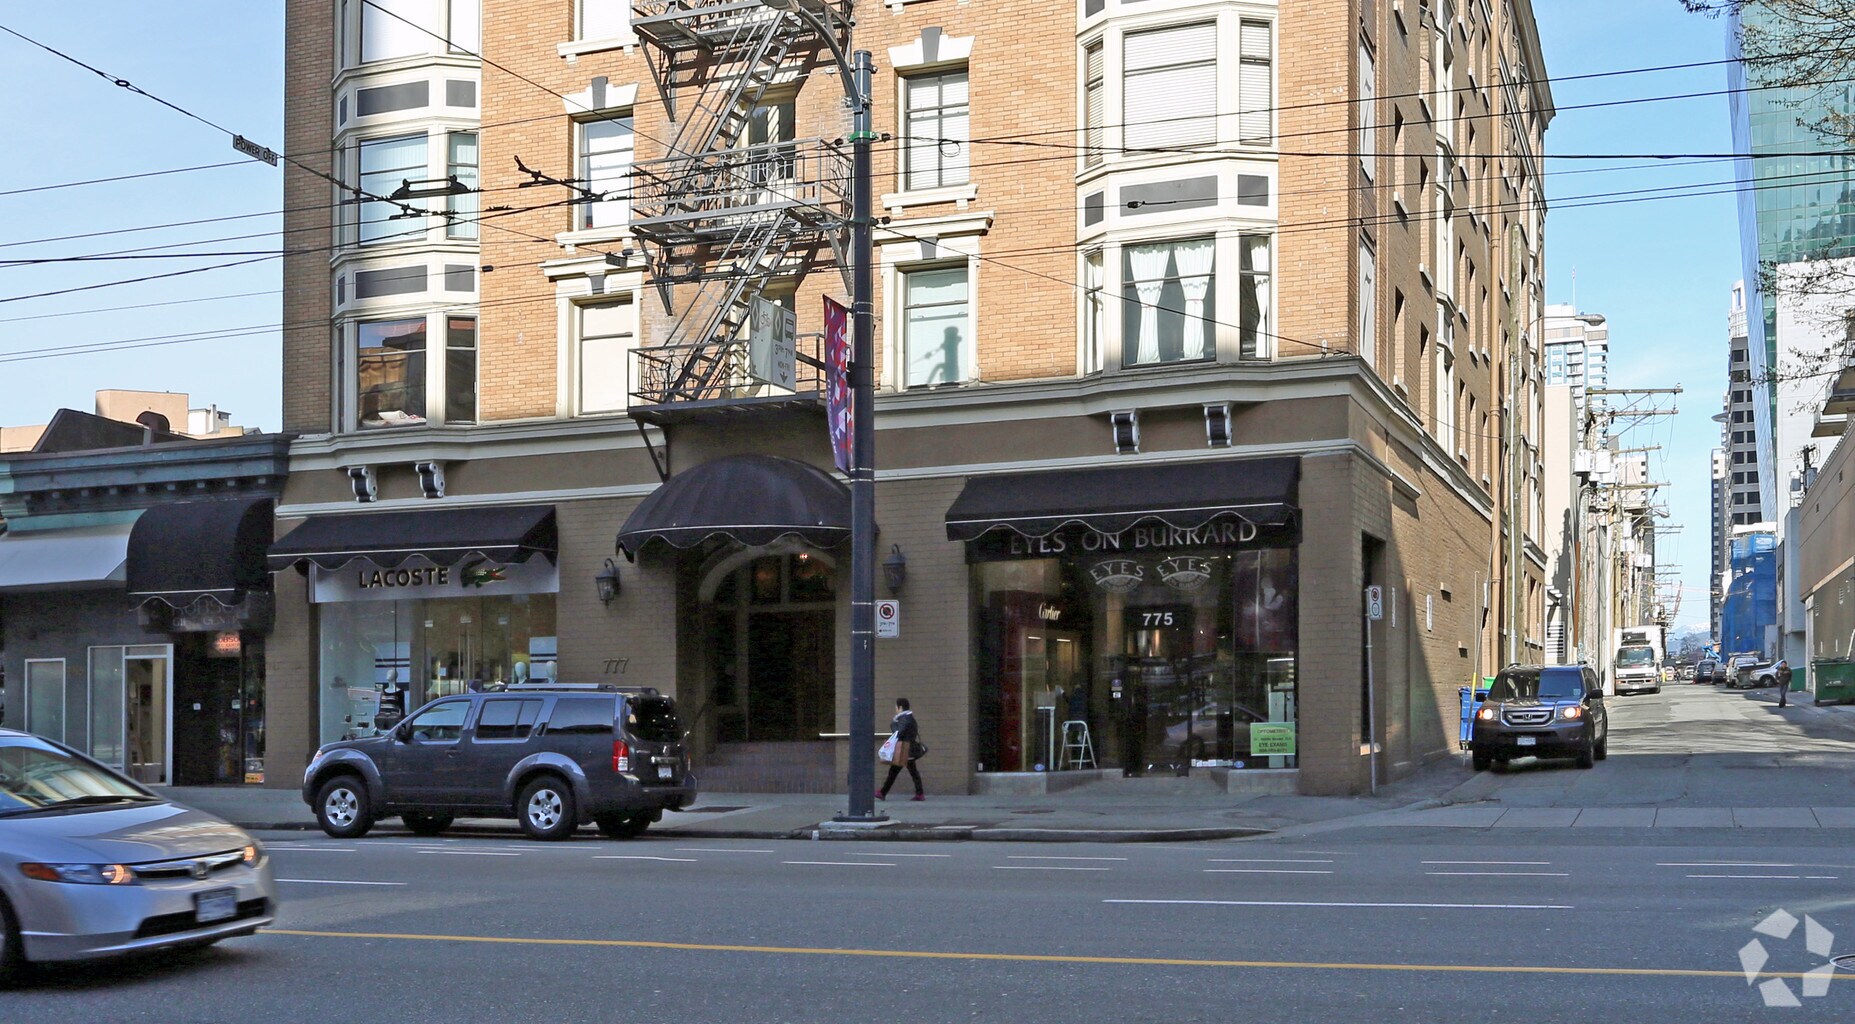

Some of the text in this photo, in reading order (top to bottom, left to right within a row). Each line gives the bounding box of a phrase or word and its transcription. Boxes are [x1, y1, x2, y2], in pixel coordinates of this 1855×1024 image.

[235, 138, 276, 163] POWER OFF
[1010, 523, 1257, 554] EYES ON BURRARD
[1089, 562, 1144, 581] EYES
[1156, 558, 1212, 577] EYES
[358, 567, 450, 588] LACOSTE
[1038, 602, 1061, 621] Cartier
[1142, 612, 1174, 627] 775
[603, 657, 630, 674] 777
